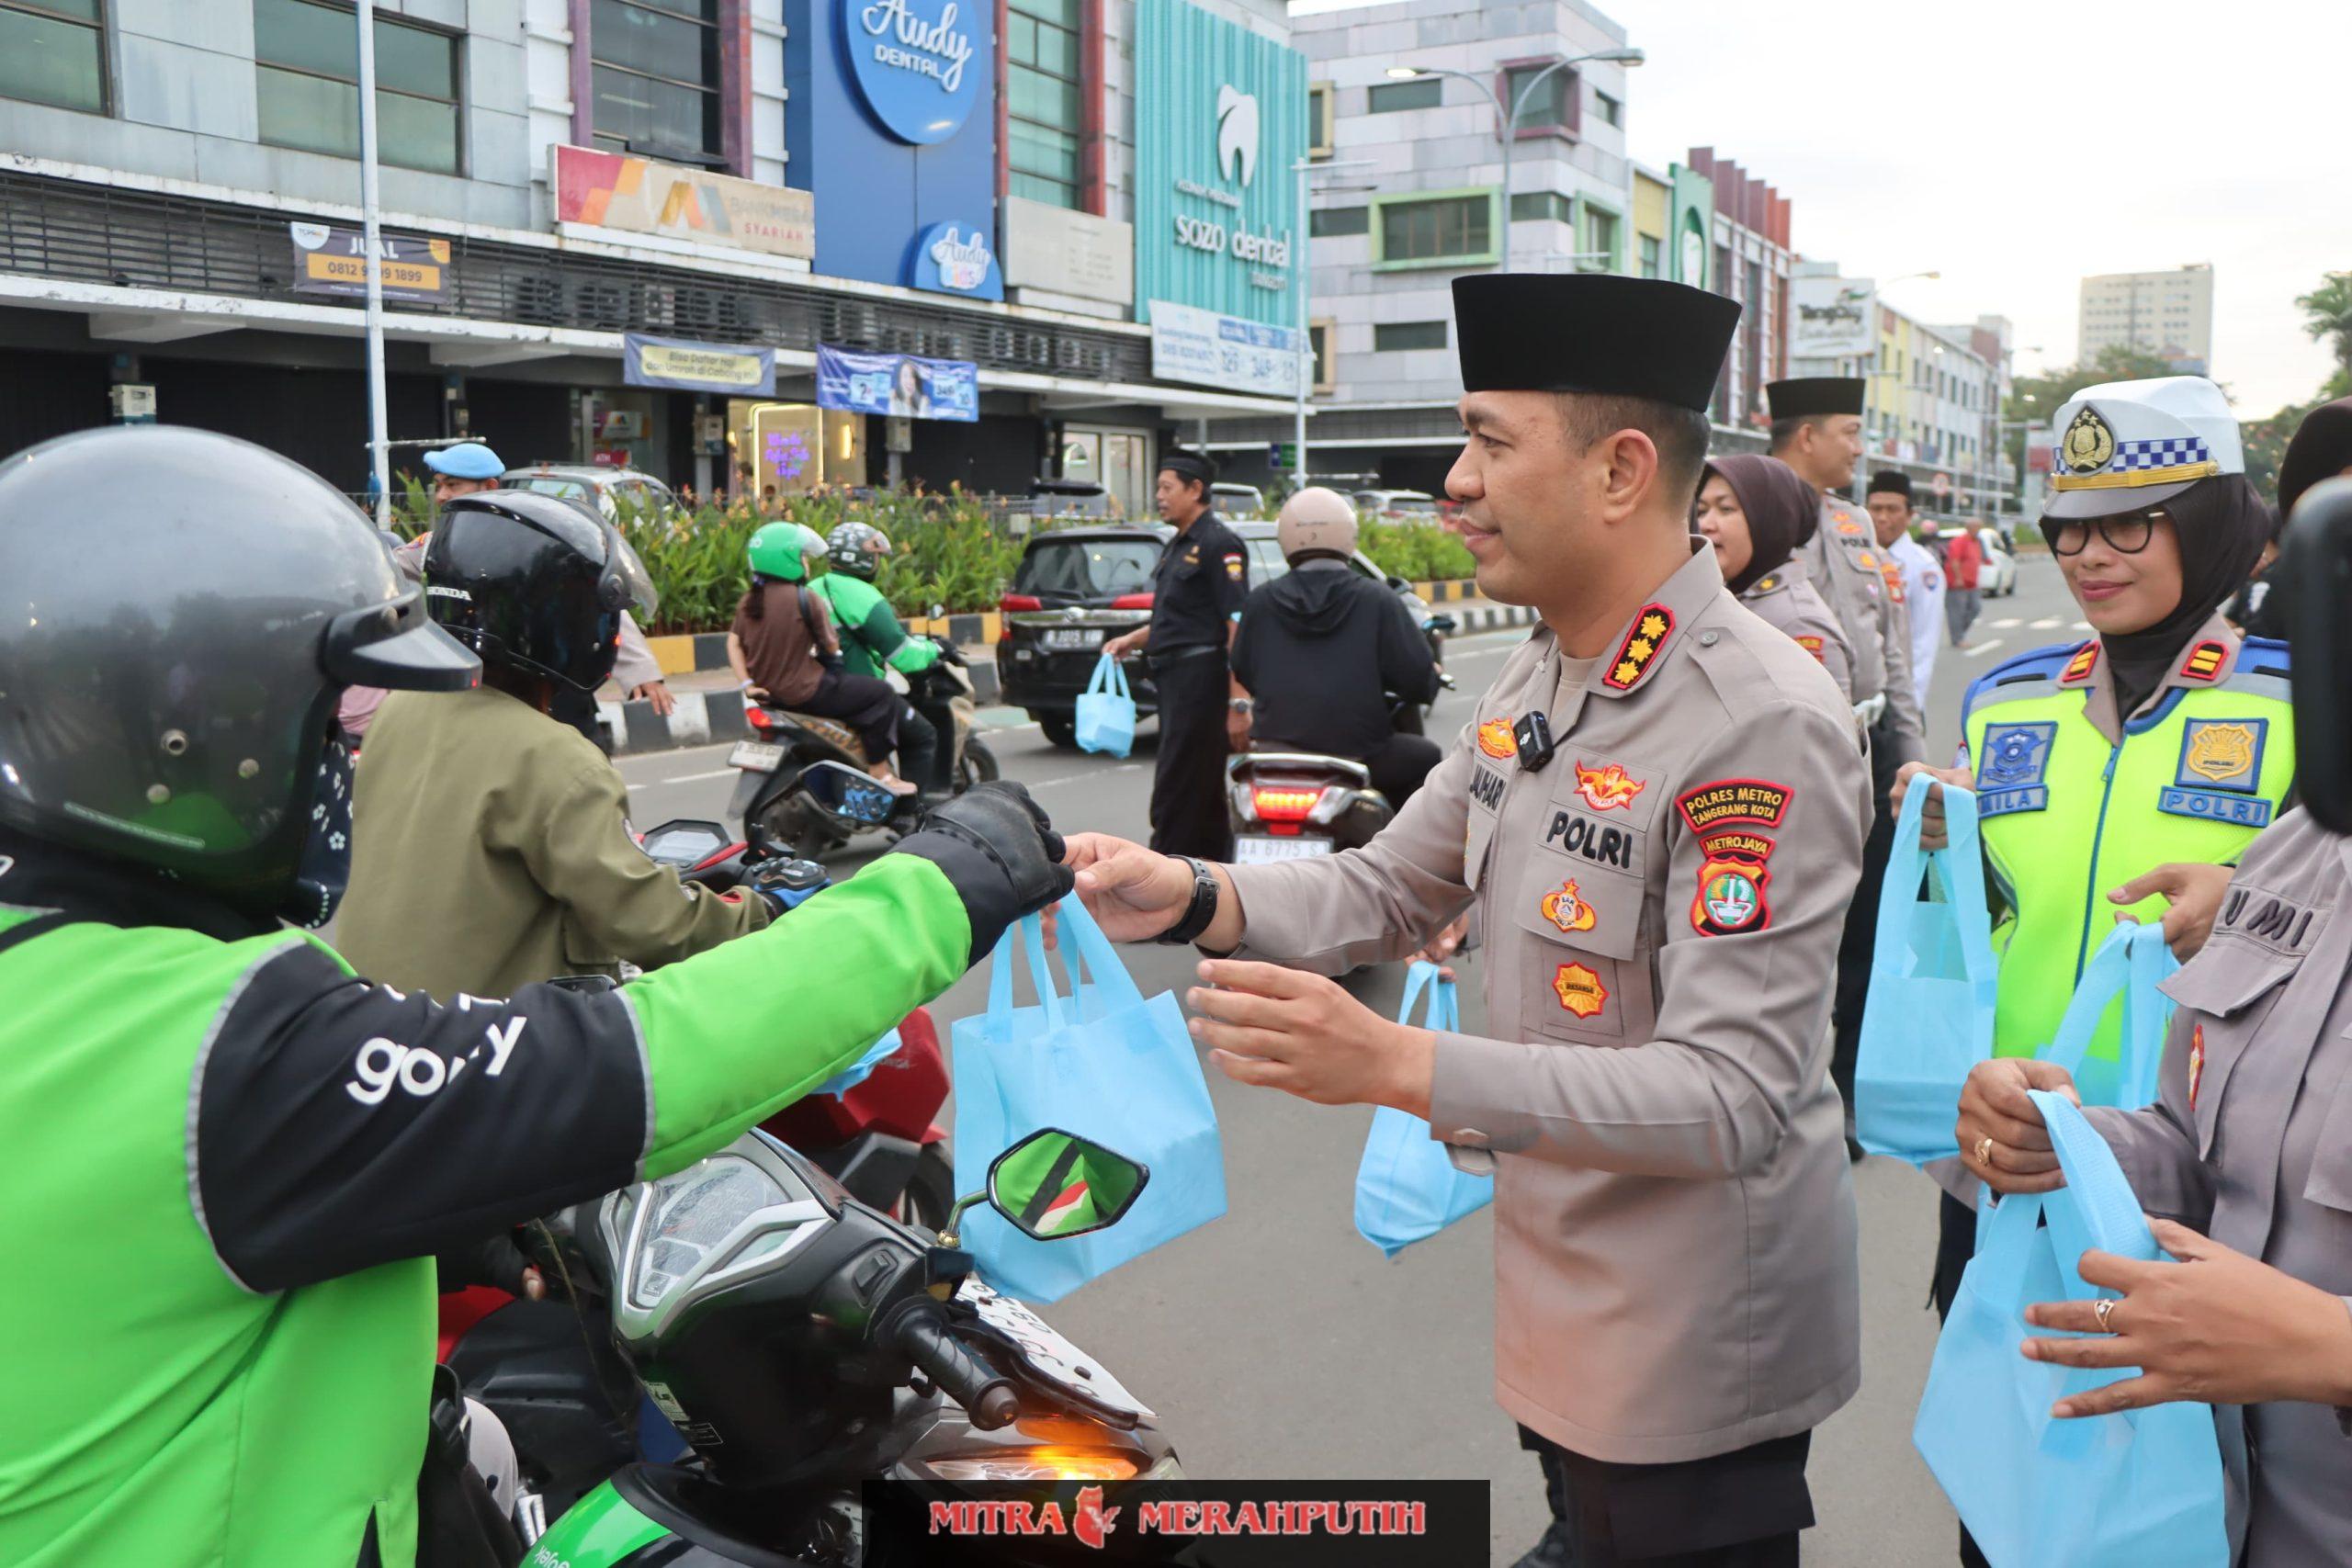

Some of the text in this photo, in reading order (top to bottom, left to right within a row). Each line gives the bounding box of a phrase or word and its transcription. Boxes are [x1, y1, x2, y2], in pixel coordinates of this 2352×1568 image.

[862, 0, 973, 92] Audy
[874, 44, 943, 79] DENTAL
[745, 222, 804, 242] SYARIAH
[1176, 214, 1290, 267] sozo dental
[327, 262, 357, 276] 0812
[395, 268, 423, 282] 1899
[595, 453, 611, 463] ATM
[1686, 788, 1782, 815] POLRES METRO
[1980, 790, 2031, 814] MILA
[2166, 793, 2263, 821] POLRI
[1692, 804, 1775, 826] TANGERANG KOTA
[1265, 840, 1301, 857] 6775
[1546, 811, 1633, 869] POLRI
[1706, 837, 1768, 853] METROJAYA
[2225, 889, 2313, 948] UMI
